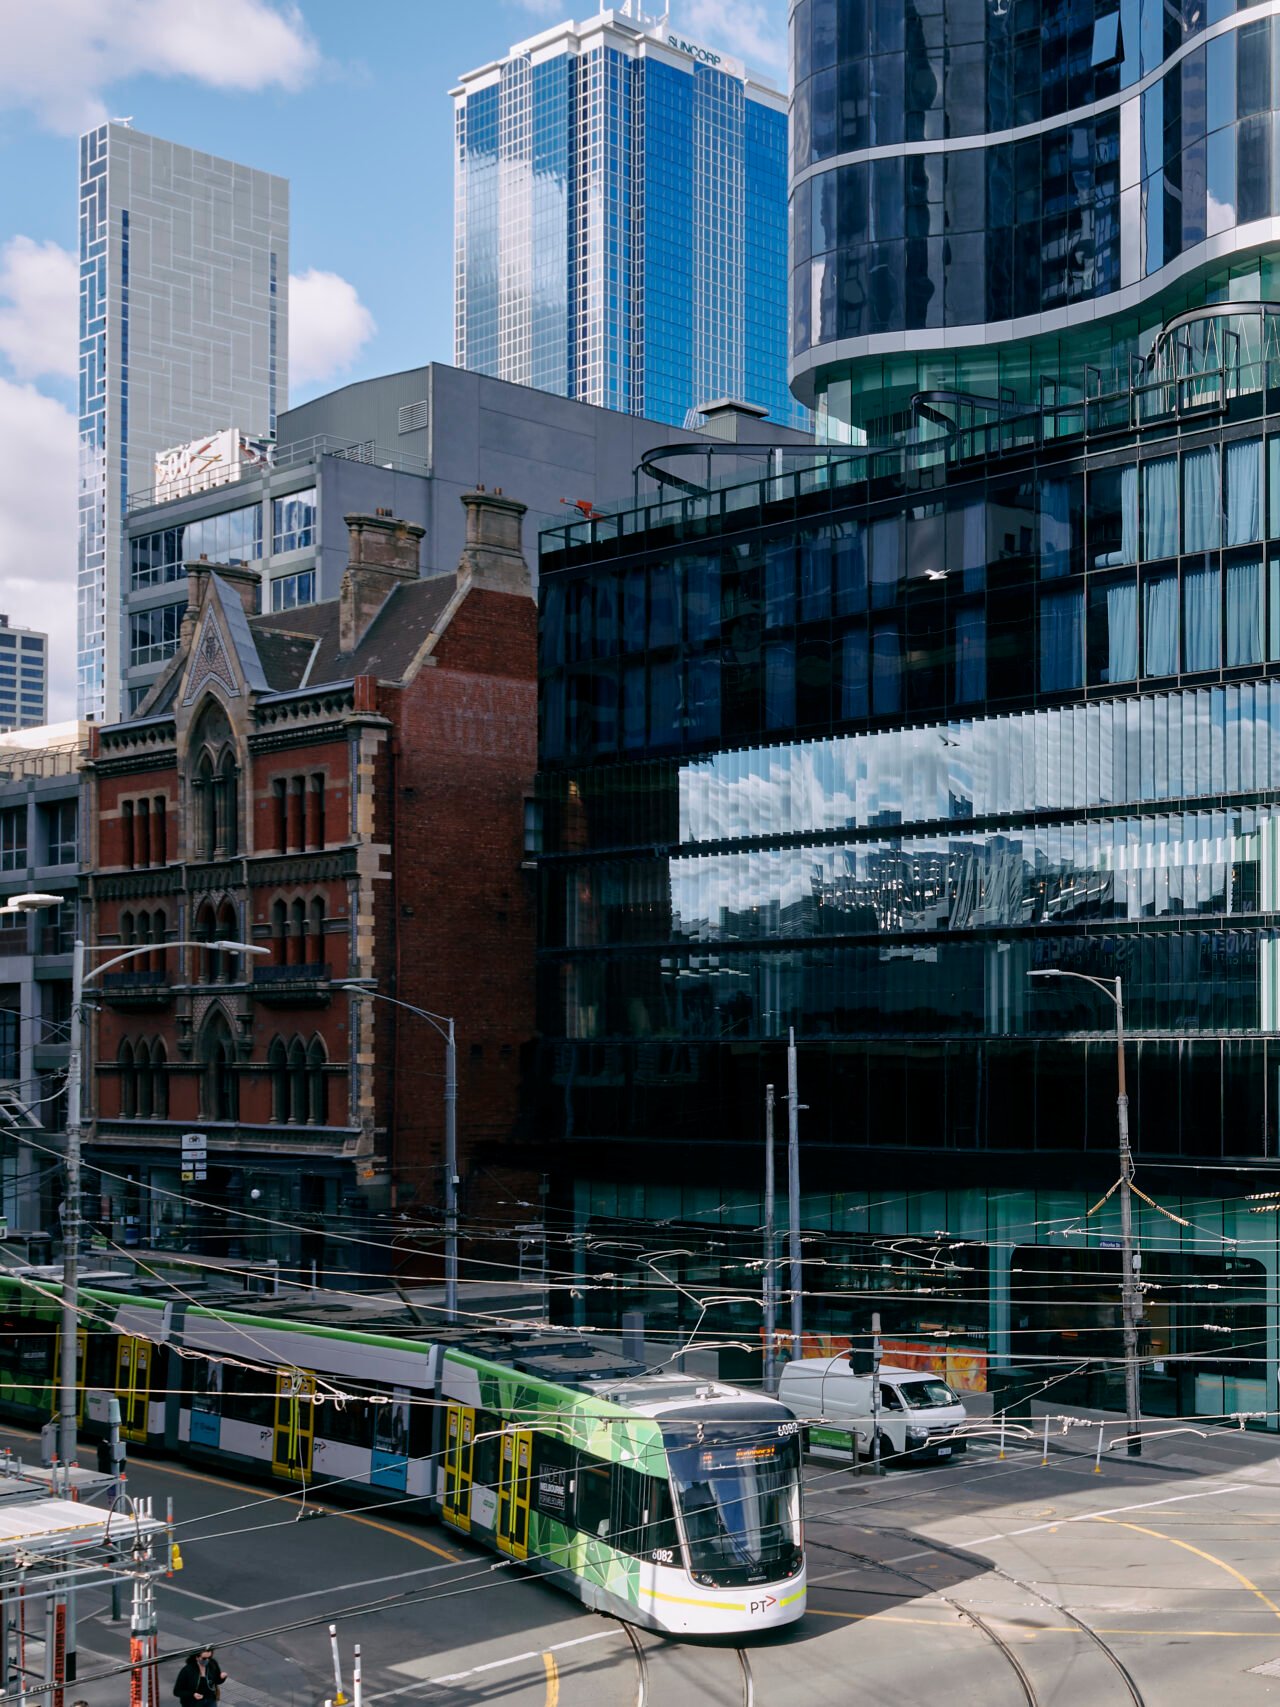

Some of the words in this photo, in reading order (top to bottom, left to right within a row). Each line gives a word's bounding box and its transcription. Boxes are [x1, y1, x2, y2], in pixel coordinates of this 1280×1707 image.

[667, 35, 721, 66] SUNCORP
[777, 1422, 799, 1437] 6082
[652, 1548, 674, 1563] 6082
